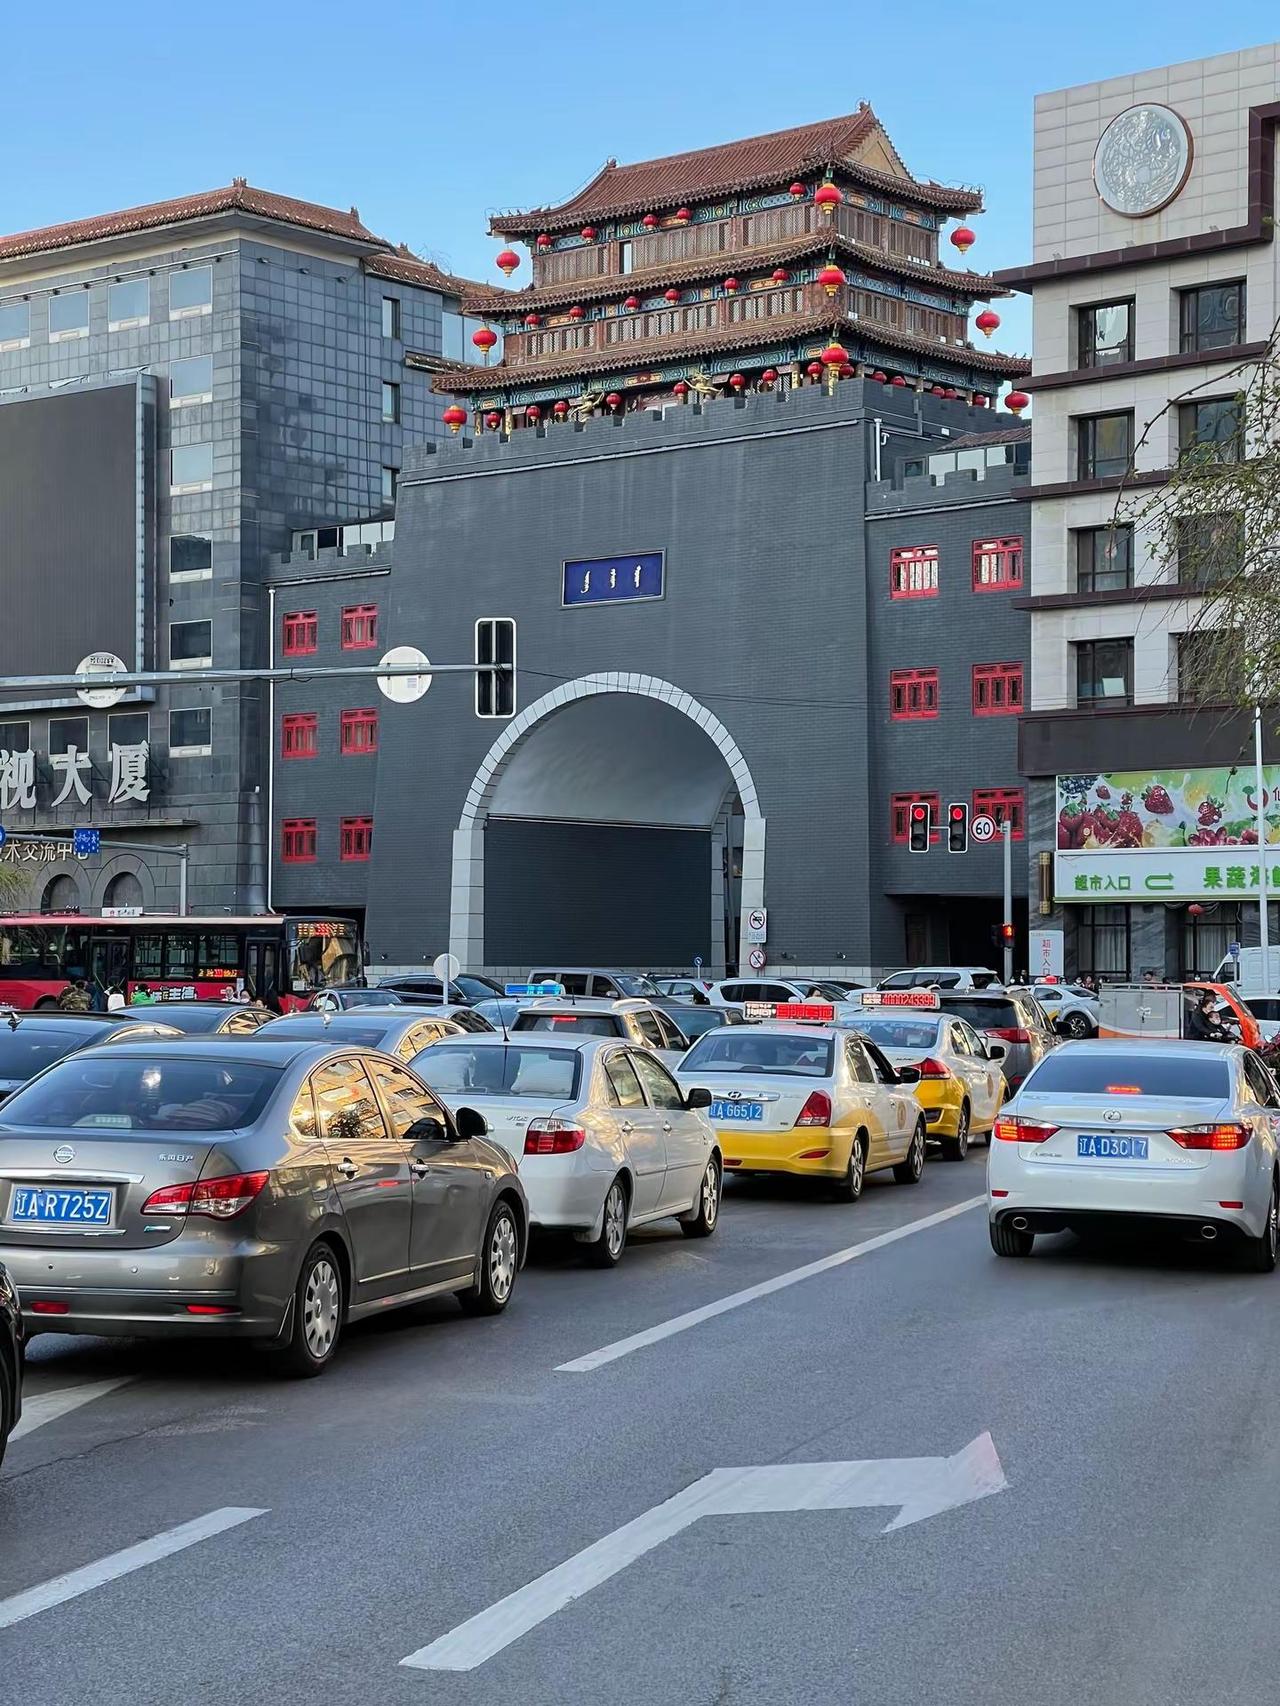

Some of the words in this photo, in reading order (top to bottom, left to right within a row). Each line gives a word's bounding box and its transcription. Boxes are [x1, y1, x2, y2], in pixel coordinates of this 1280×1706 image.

[0, 740, 151, 809] 视大厦
[975, 822, 990, 835] 60
[1074, 874, 1131, 891] 超市入口
